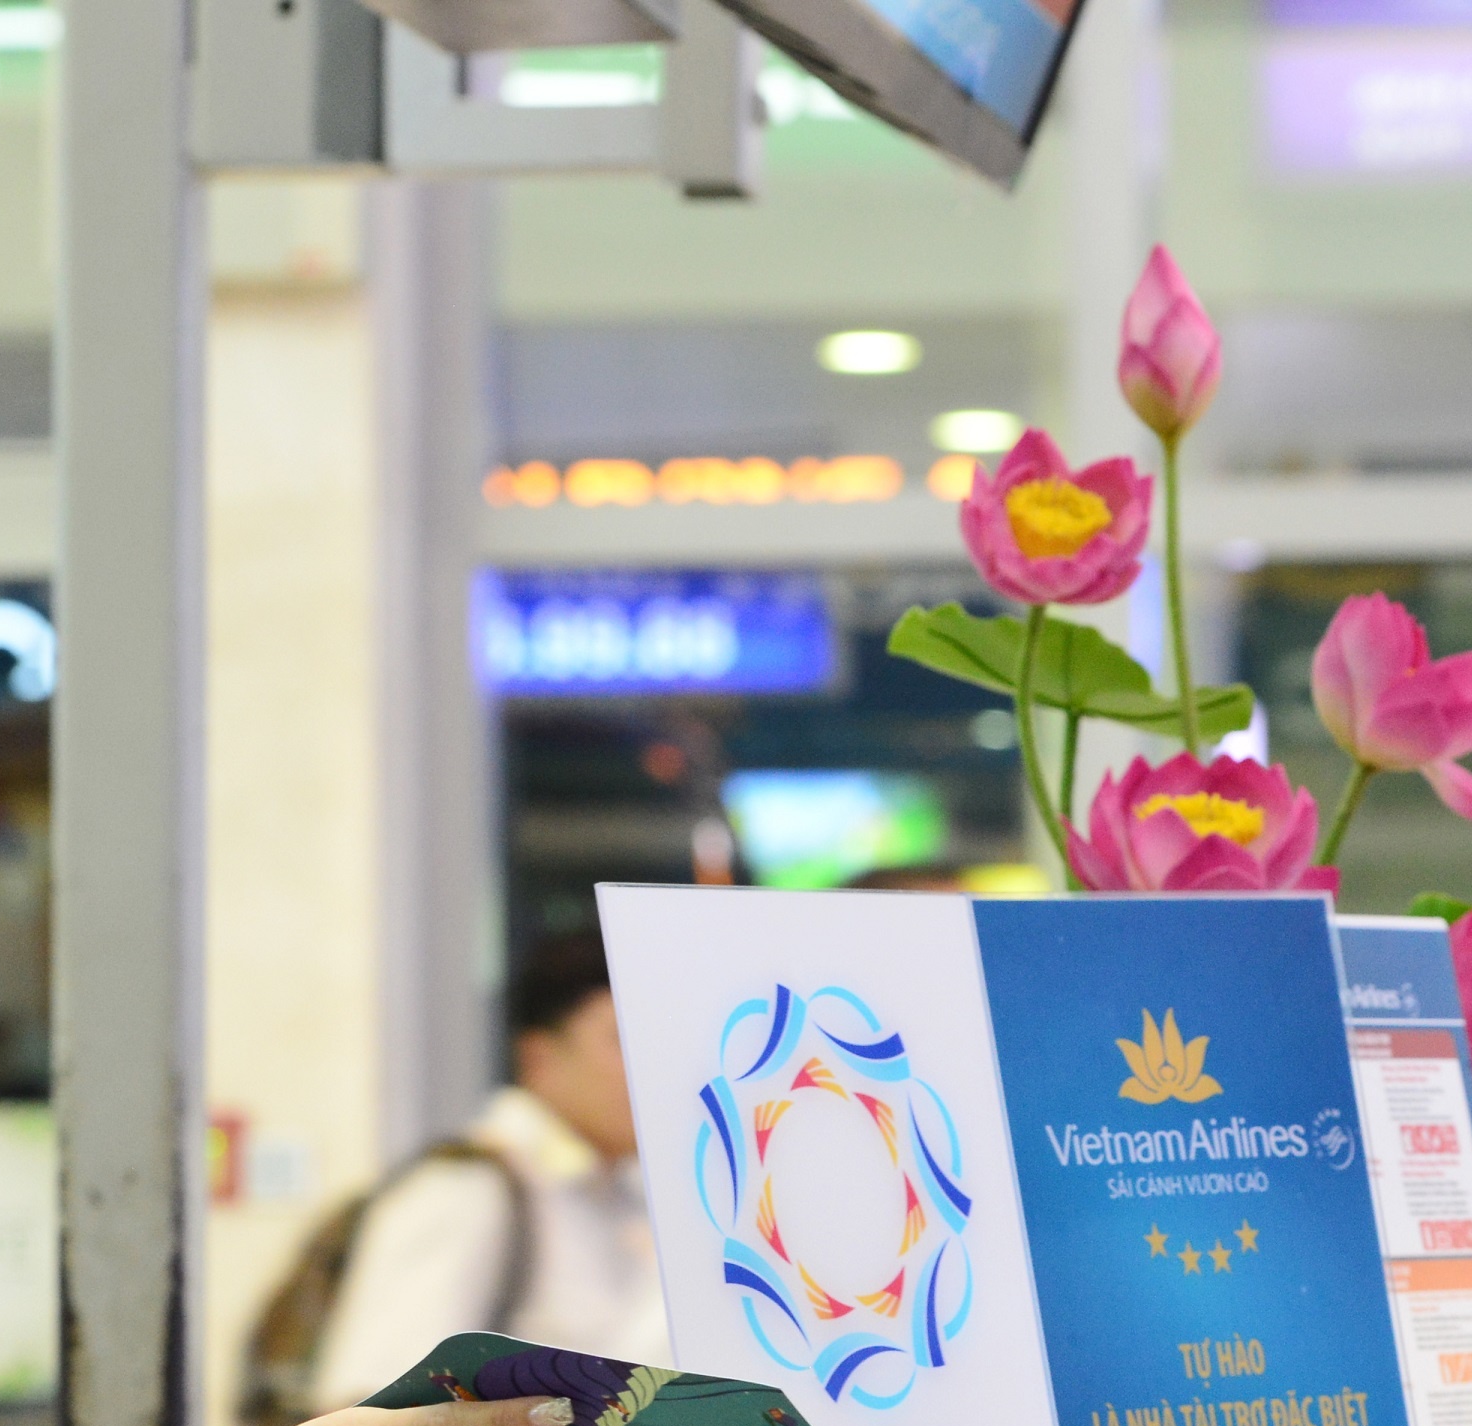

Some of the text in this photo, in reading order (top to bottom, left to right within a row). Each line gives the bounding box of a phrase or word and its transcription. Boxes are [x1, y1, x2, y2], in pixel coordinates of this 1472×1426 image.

[1045, 1123, 1188, 1167] Vietnam
[1189, 1116, 1309, 1161] Airlines
[1178, 1332, 1266, 1389] TỰ HÀO
